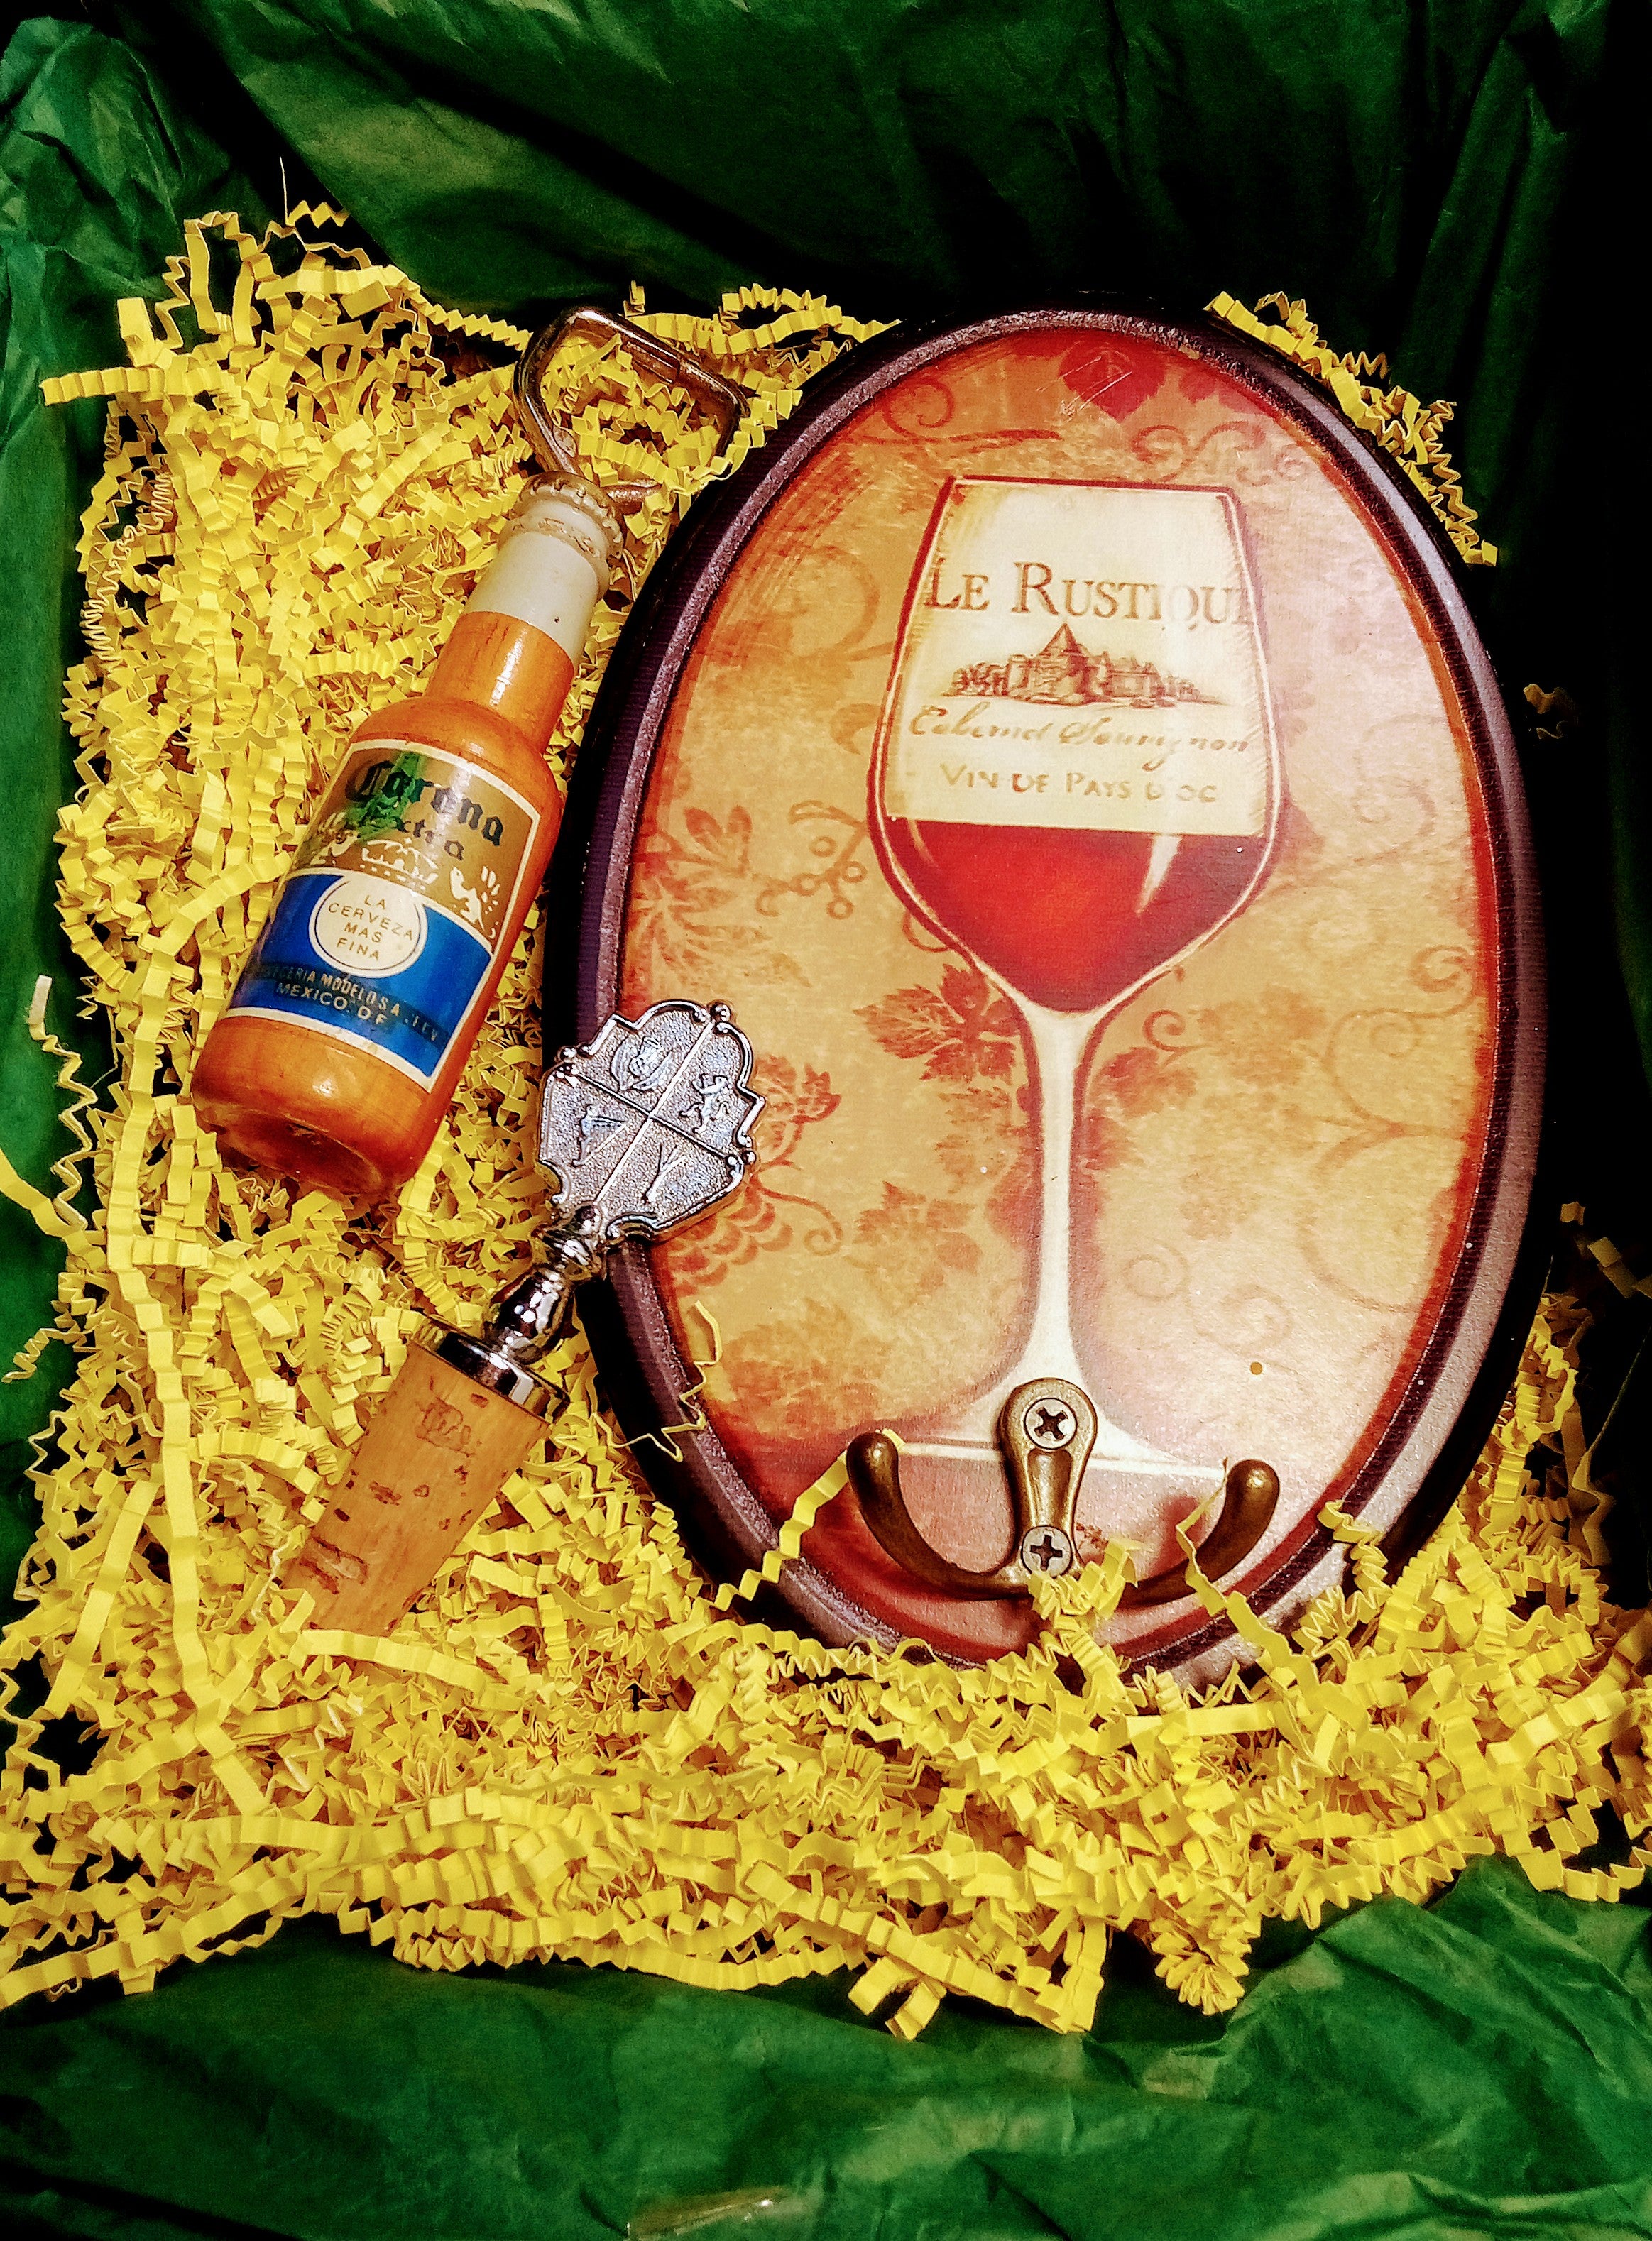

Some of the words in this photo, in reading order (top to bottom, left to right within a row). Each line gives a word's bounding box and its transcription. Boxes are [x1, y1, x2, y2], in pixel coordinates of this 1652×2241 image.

[924, 557, 990, 611] LE
[1066, 772, 1131, 800] PAYS
[364, 894, 385, 909] LA
[329, 902, 412, 941] CERVEZA
[344, 922, 382, 943] MAS
[336, 938, 379, 961] FINA
